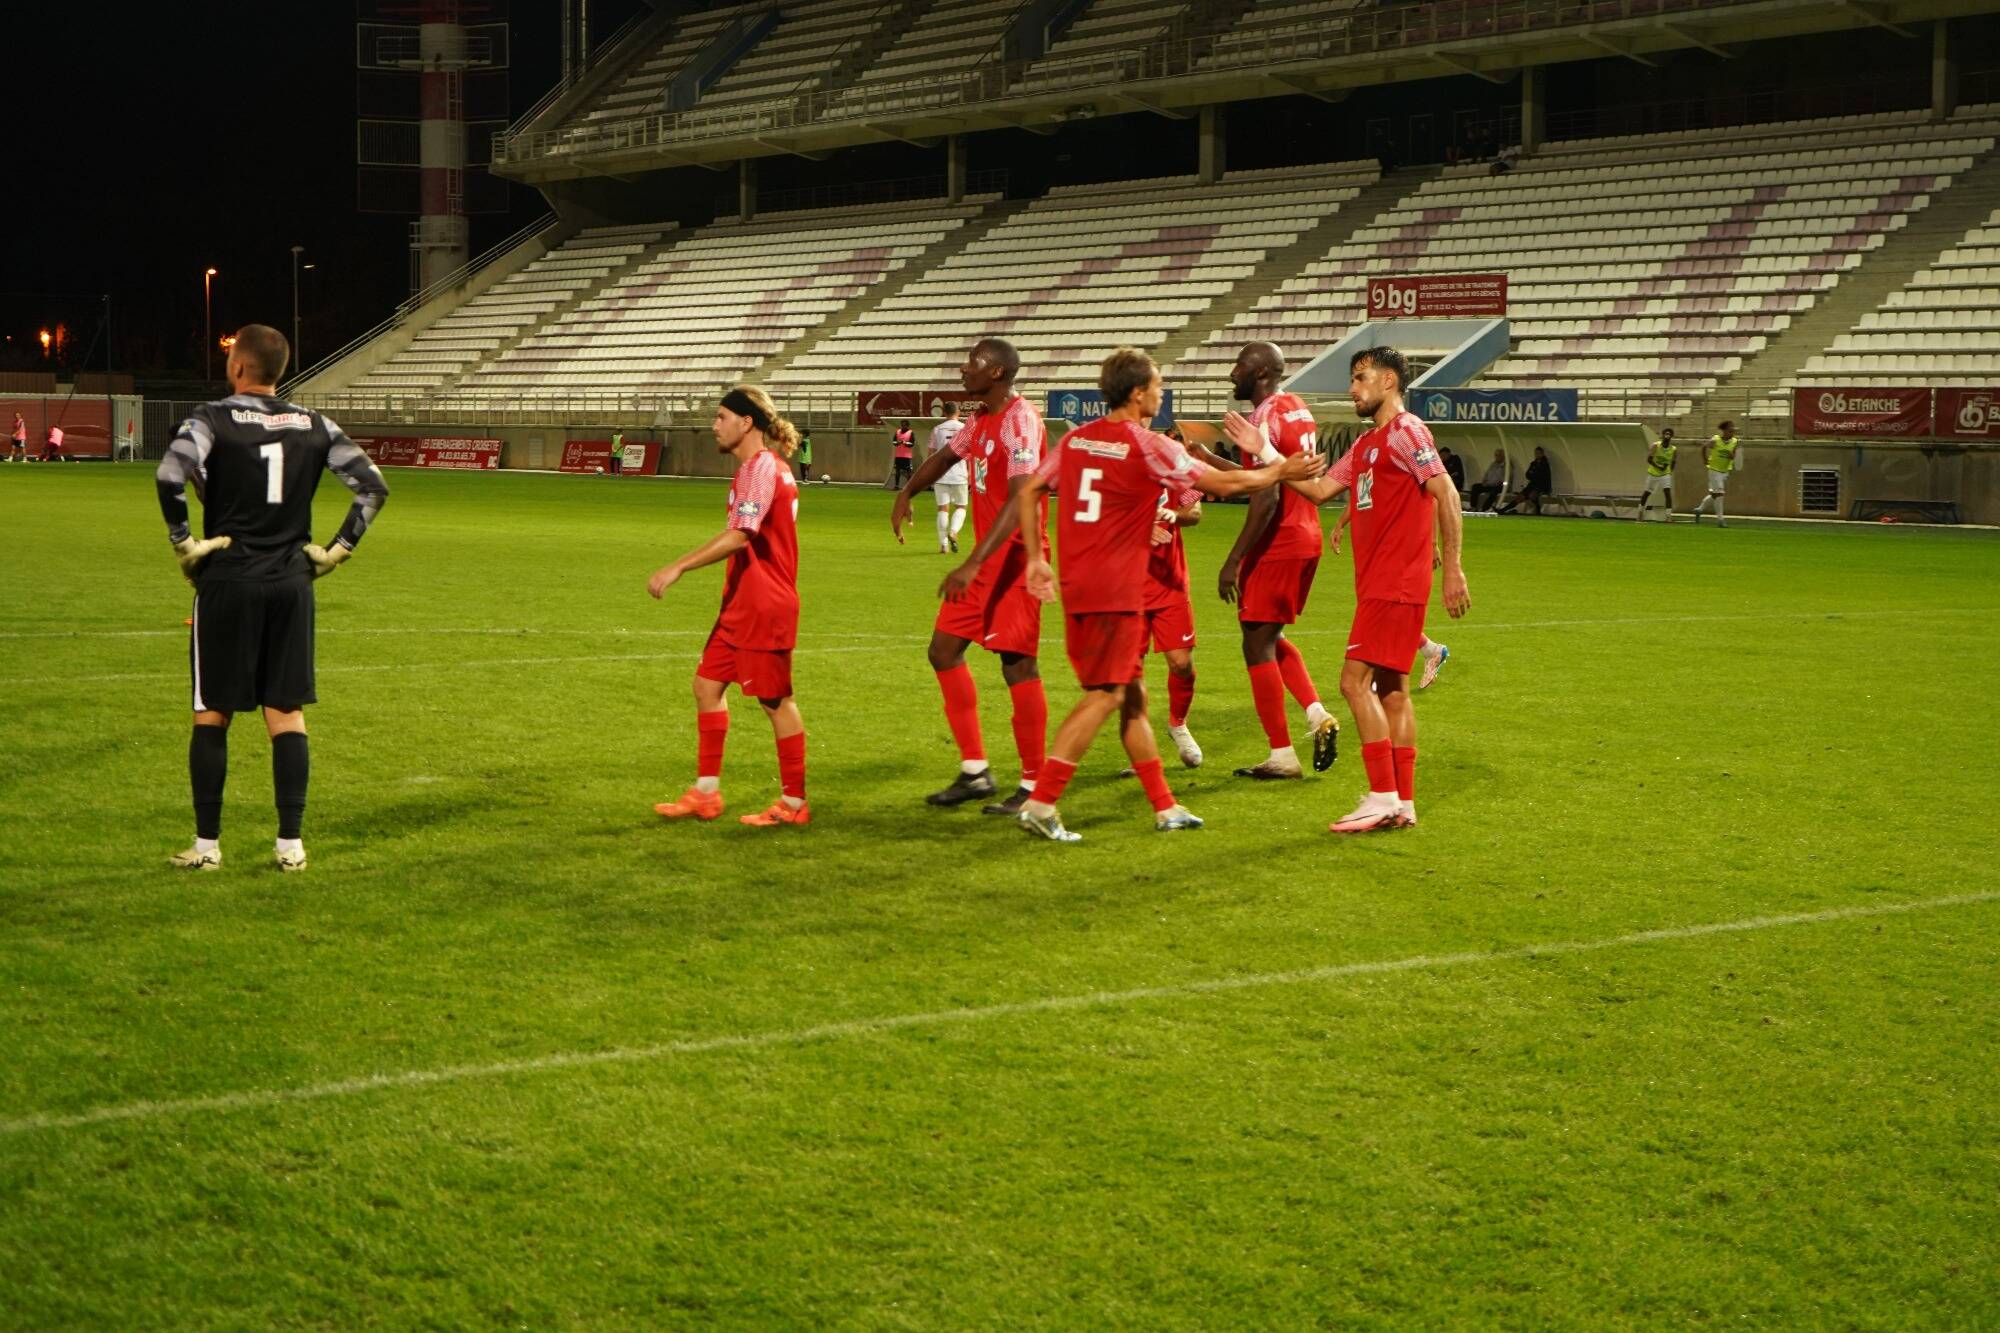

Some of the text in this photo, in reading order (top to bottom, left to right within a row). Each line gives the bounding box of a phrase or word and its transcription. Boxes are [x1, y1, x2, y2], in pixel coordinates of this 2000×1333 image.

[1387, 283, 1417, 315] bg
[1062, 401, 1076, 415] N2
[1428, 401, 1559, 421] N2 NATIONAL 2
[1848, 398, 1900, 412] ETANCHE
[259, 441, 284, 504] 1
[1074, 467, 1104, 523] 5
